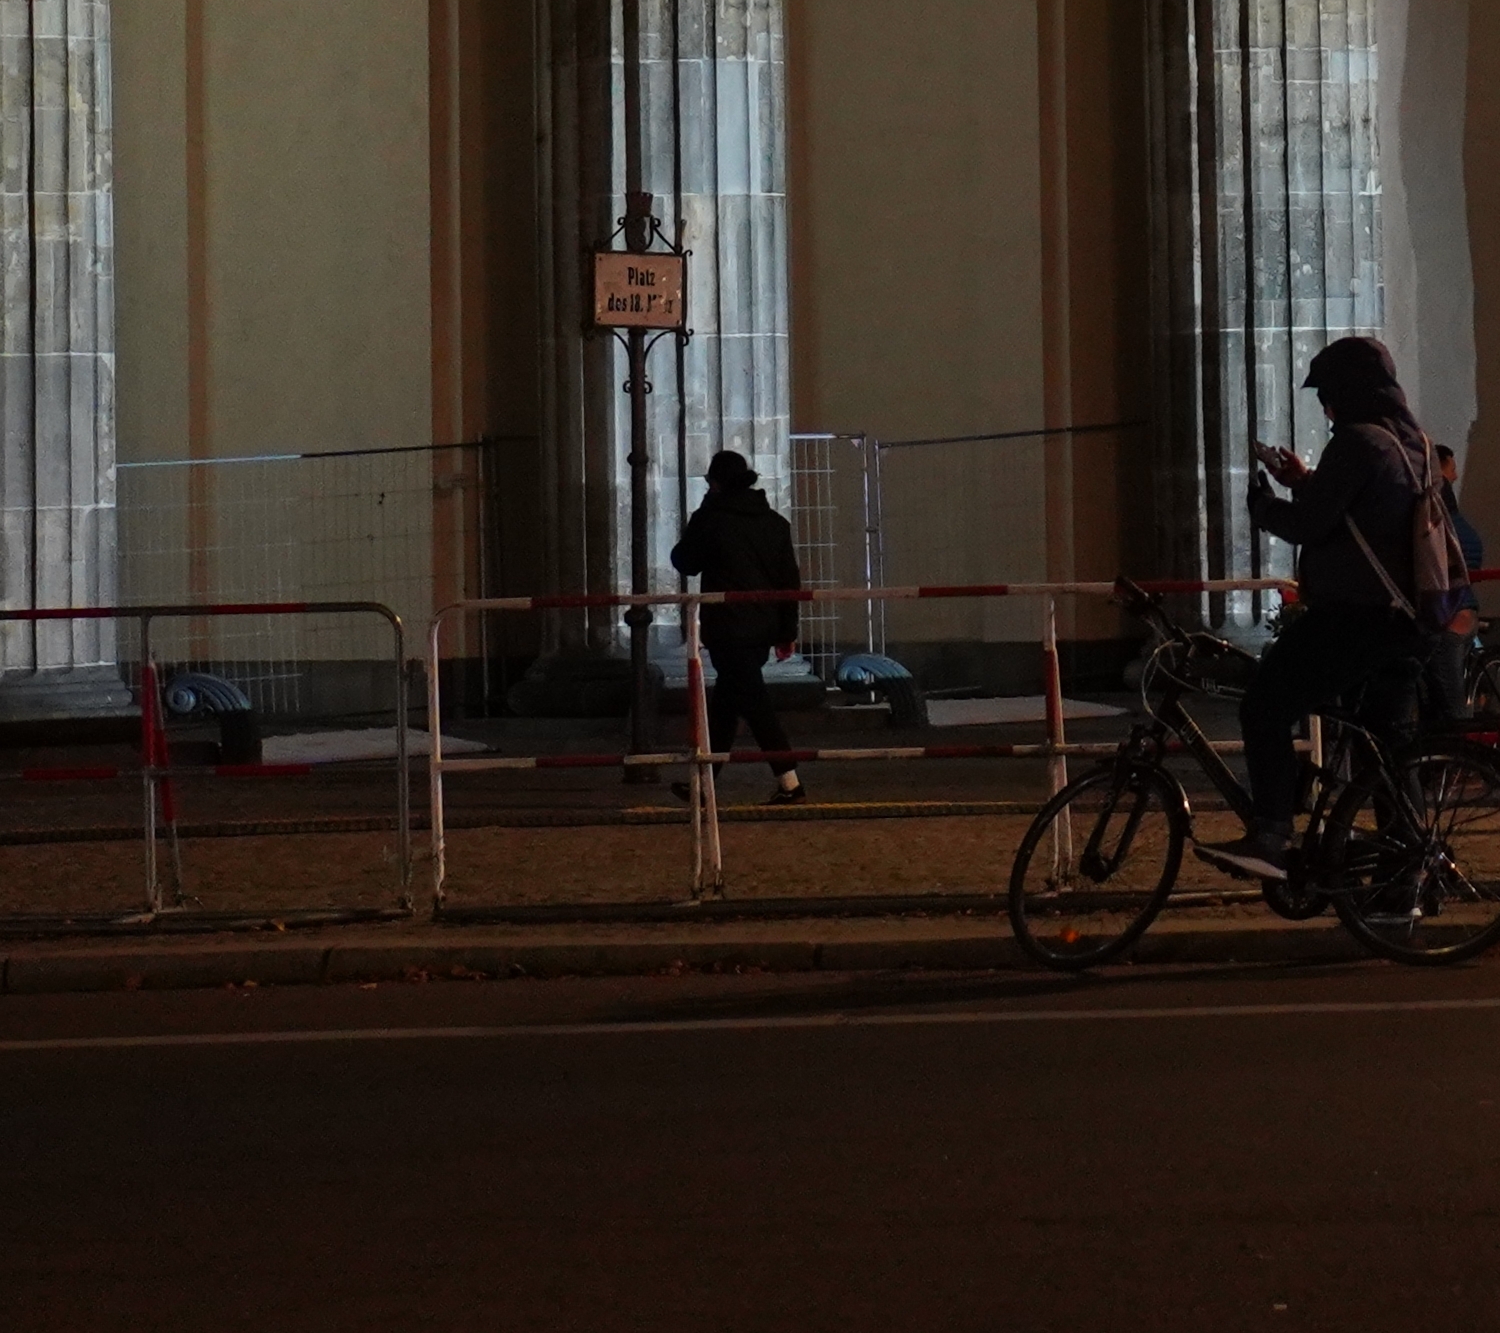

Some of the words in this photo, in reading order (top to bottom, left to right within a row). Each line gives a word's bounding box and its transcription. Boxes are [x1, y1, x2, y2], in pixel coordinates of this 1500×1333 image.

[627, 267, 655, 286] Platz
[608, 293, 627, 312] des
[630, 294, 643, 313] 18.
